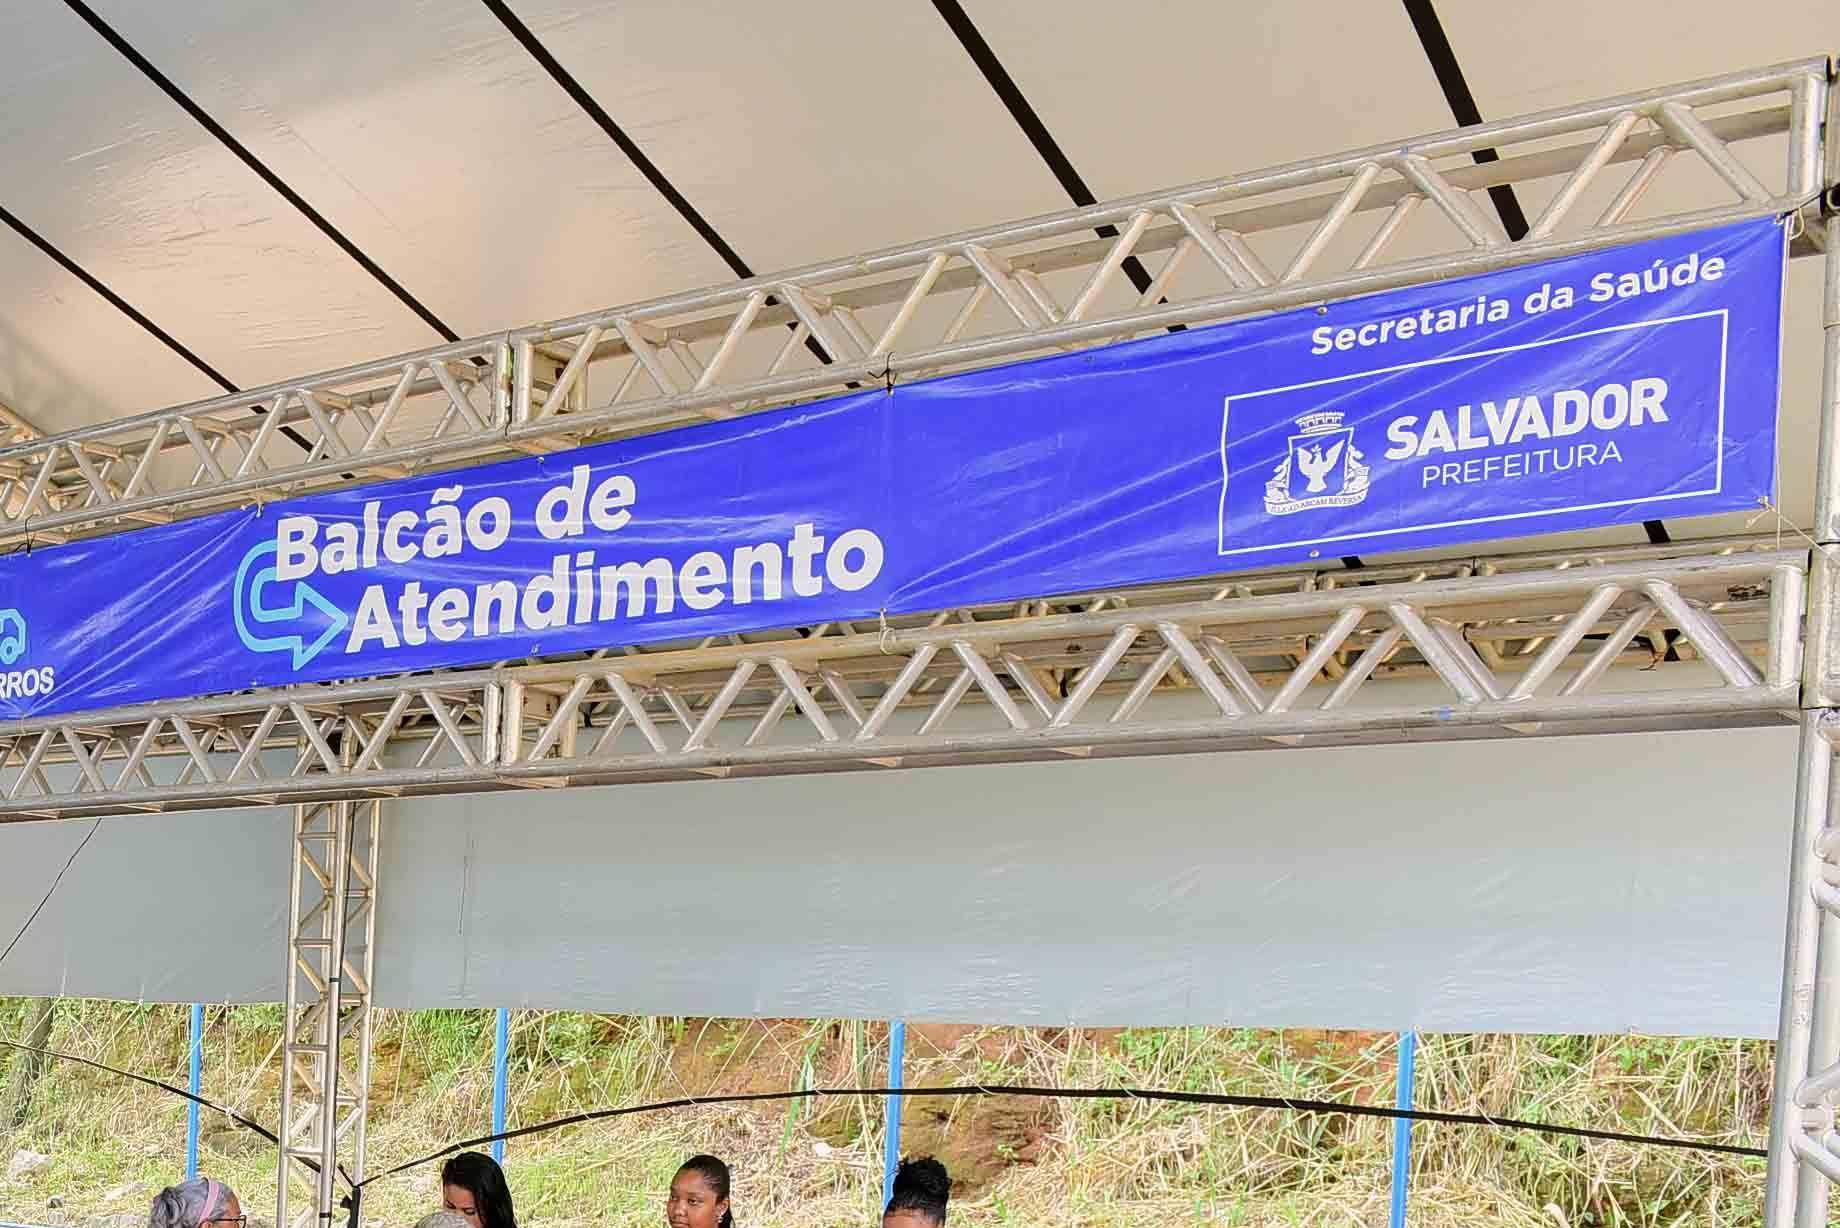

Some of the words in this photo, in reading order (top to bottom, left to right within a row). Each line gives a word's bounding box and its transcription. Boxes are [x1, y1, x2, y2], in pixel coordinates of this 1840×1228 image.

[1311, 294, 1510, 356] Secretaria
[1523, 283, 1574, 316] da
[1589, 253, 1727, 303] Saúde
[1383, 376, 1669, 462] SALVADOR
[1421, 440, 1623, 489] PREFEITURA
[276, 484, 512, 582] Balcão
[535, 464, 637, 541] de
[346, 522, 885, 654] Atendimento
